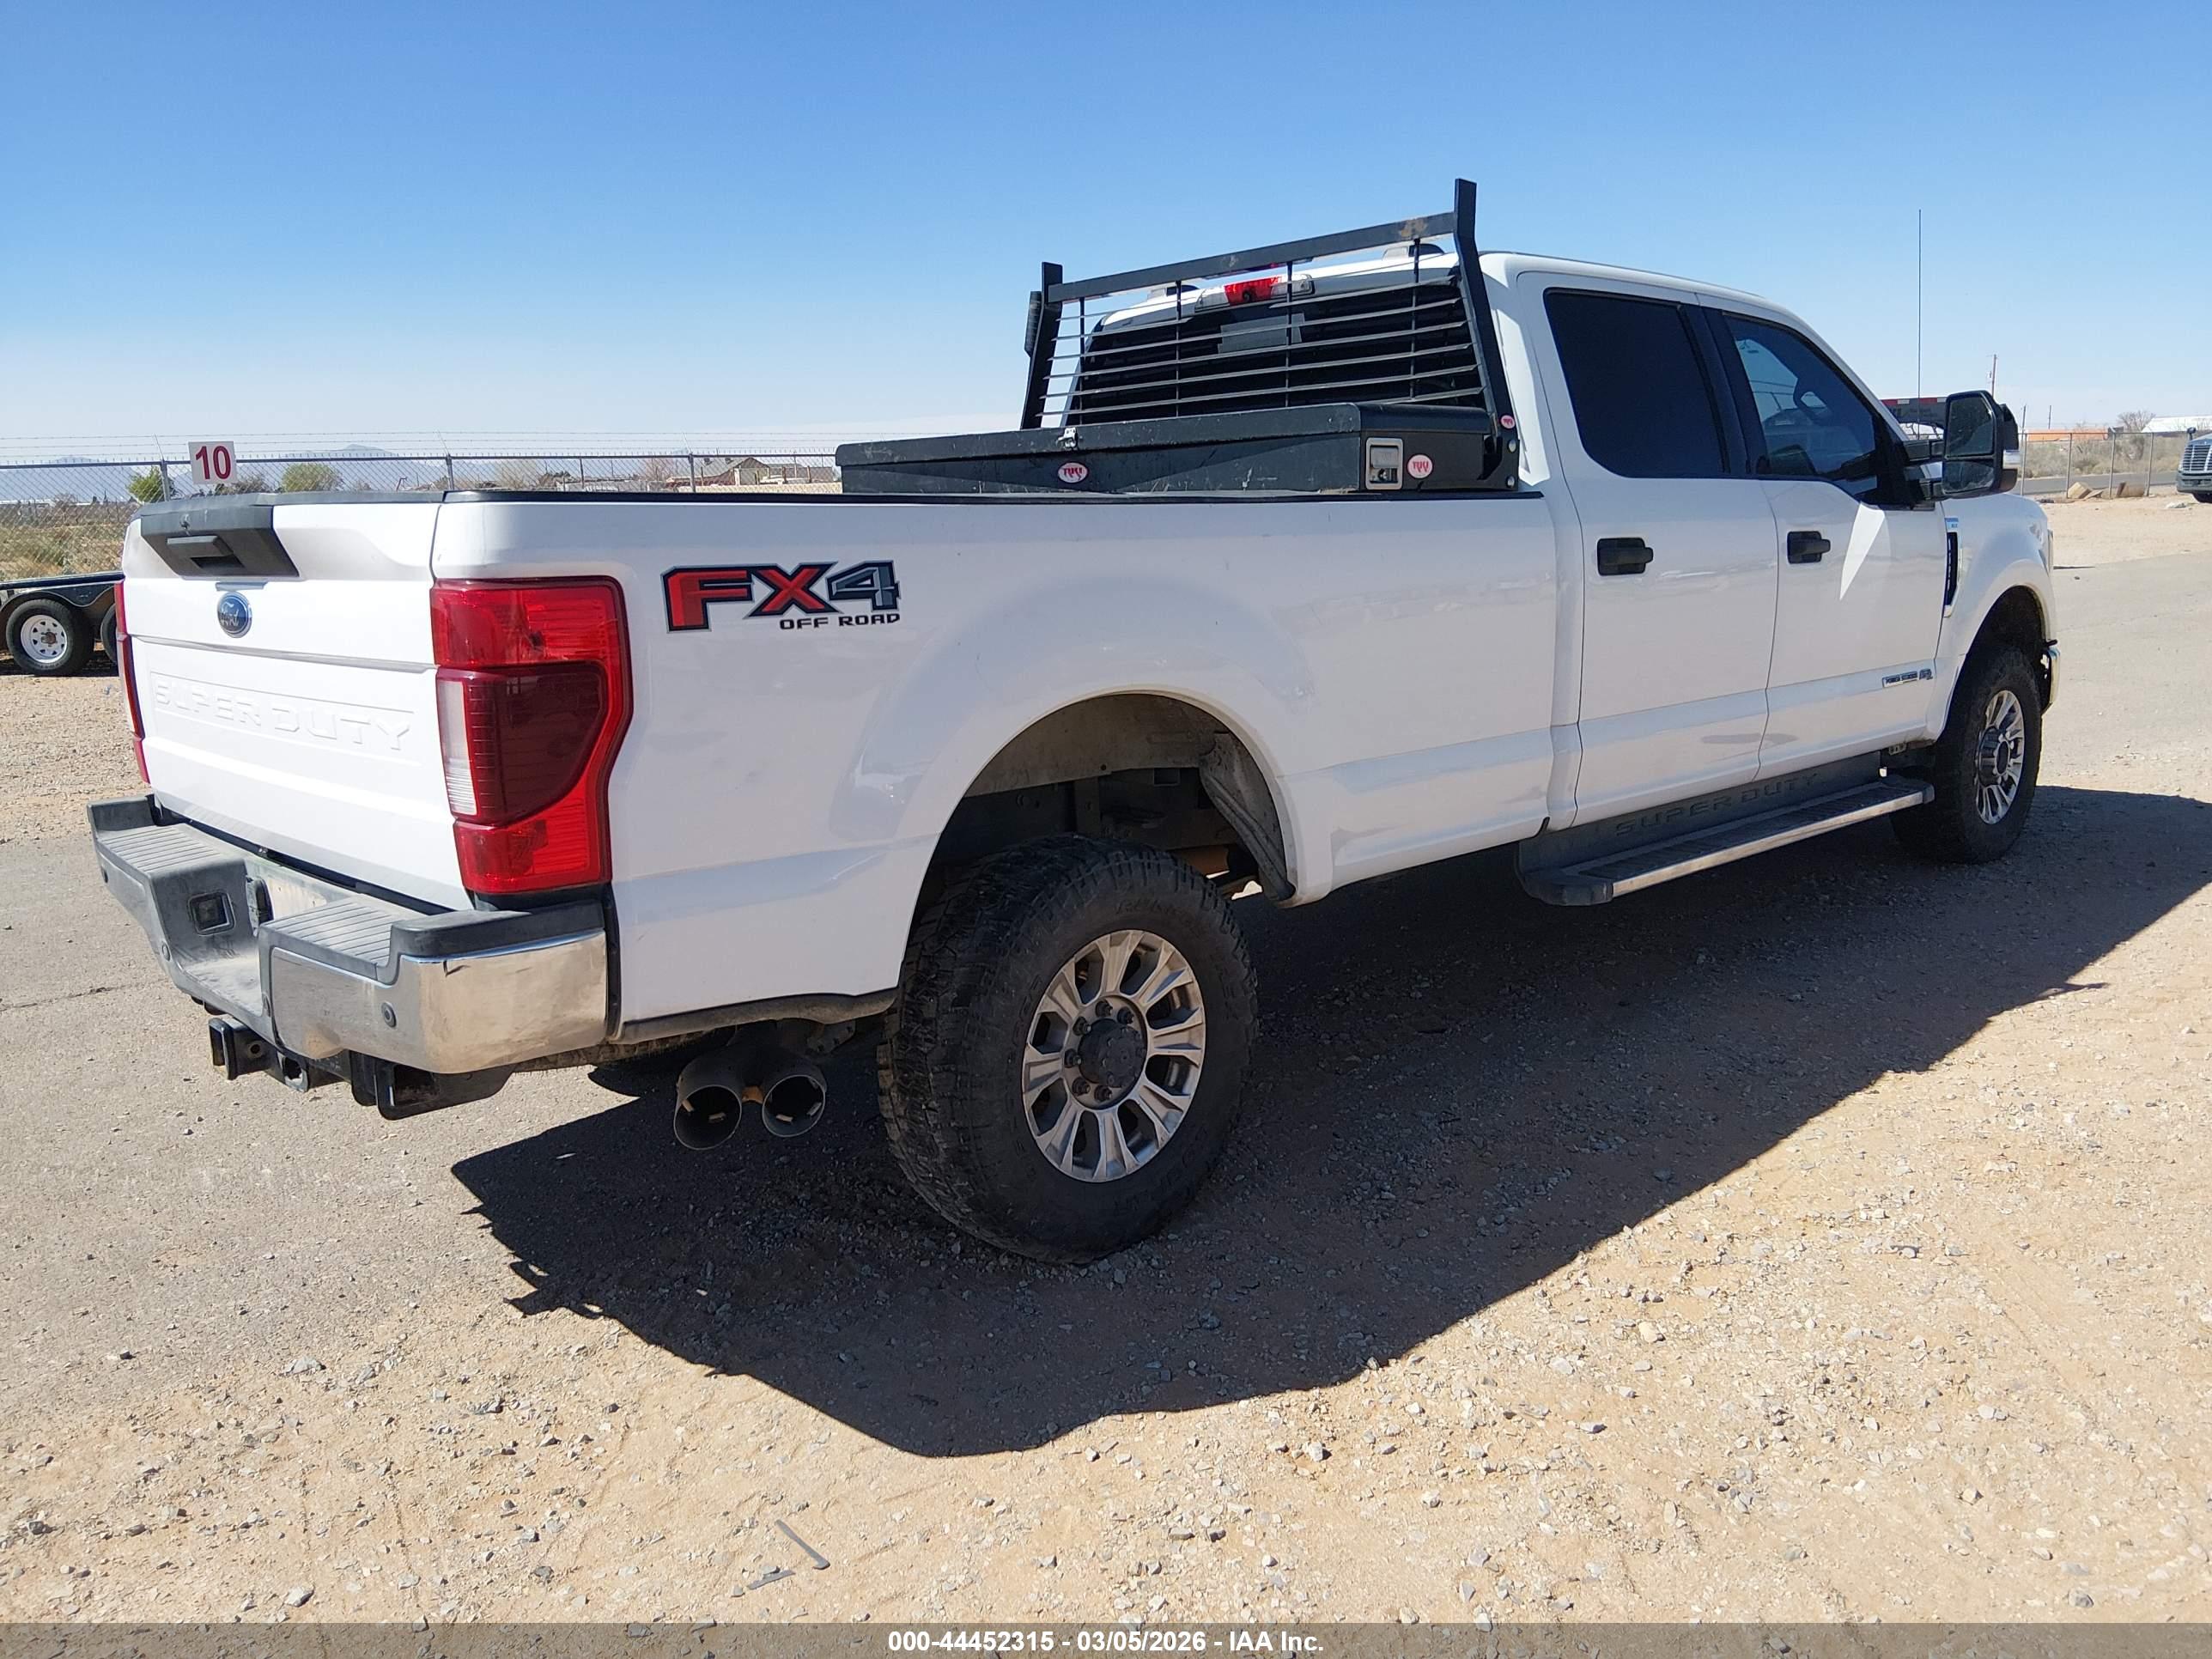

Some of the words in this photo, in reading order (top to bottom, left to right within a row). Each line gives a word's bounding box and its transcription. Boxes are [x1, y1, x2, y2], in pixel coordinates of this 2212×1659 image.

[195, 445, 232, 480] 10
[659, 560, 901, 633] FX4
[779, 617, 830, 630] OFF
[838, 613, 901, 627] ROAD
[155, 683, 262, 728] SUPER
[270, 703, 410, 750] DUTY
[1615, 795, 1733, 837] SUPER
[1741, 772, 1819, 804] DUTY
